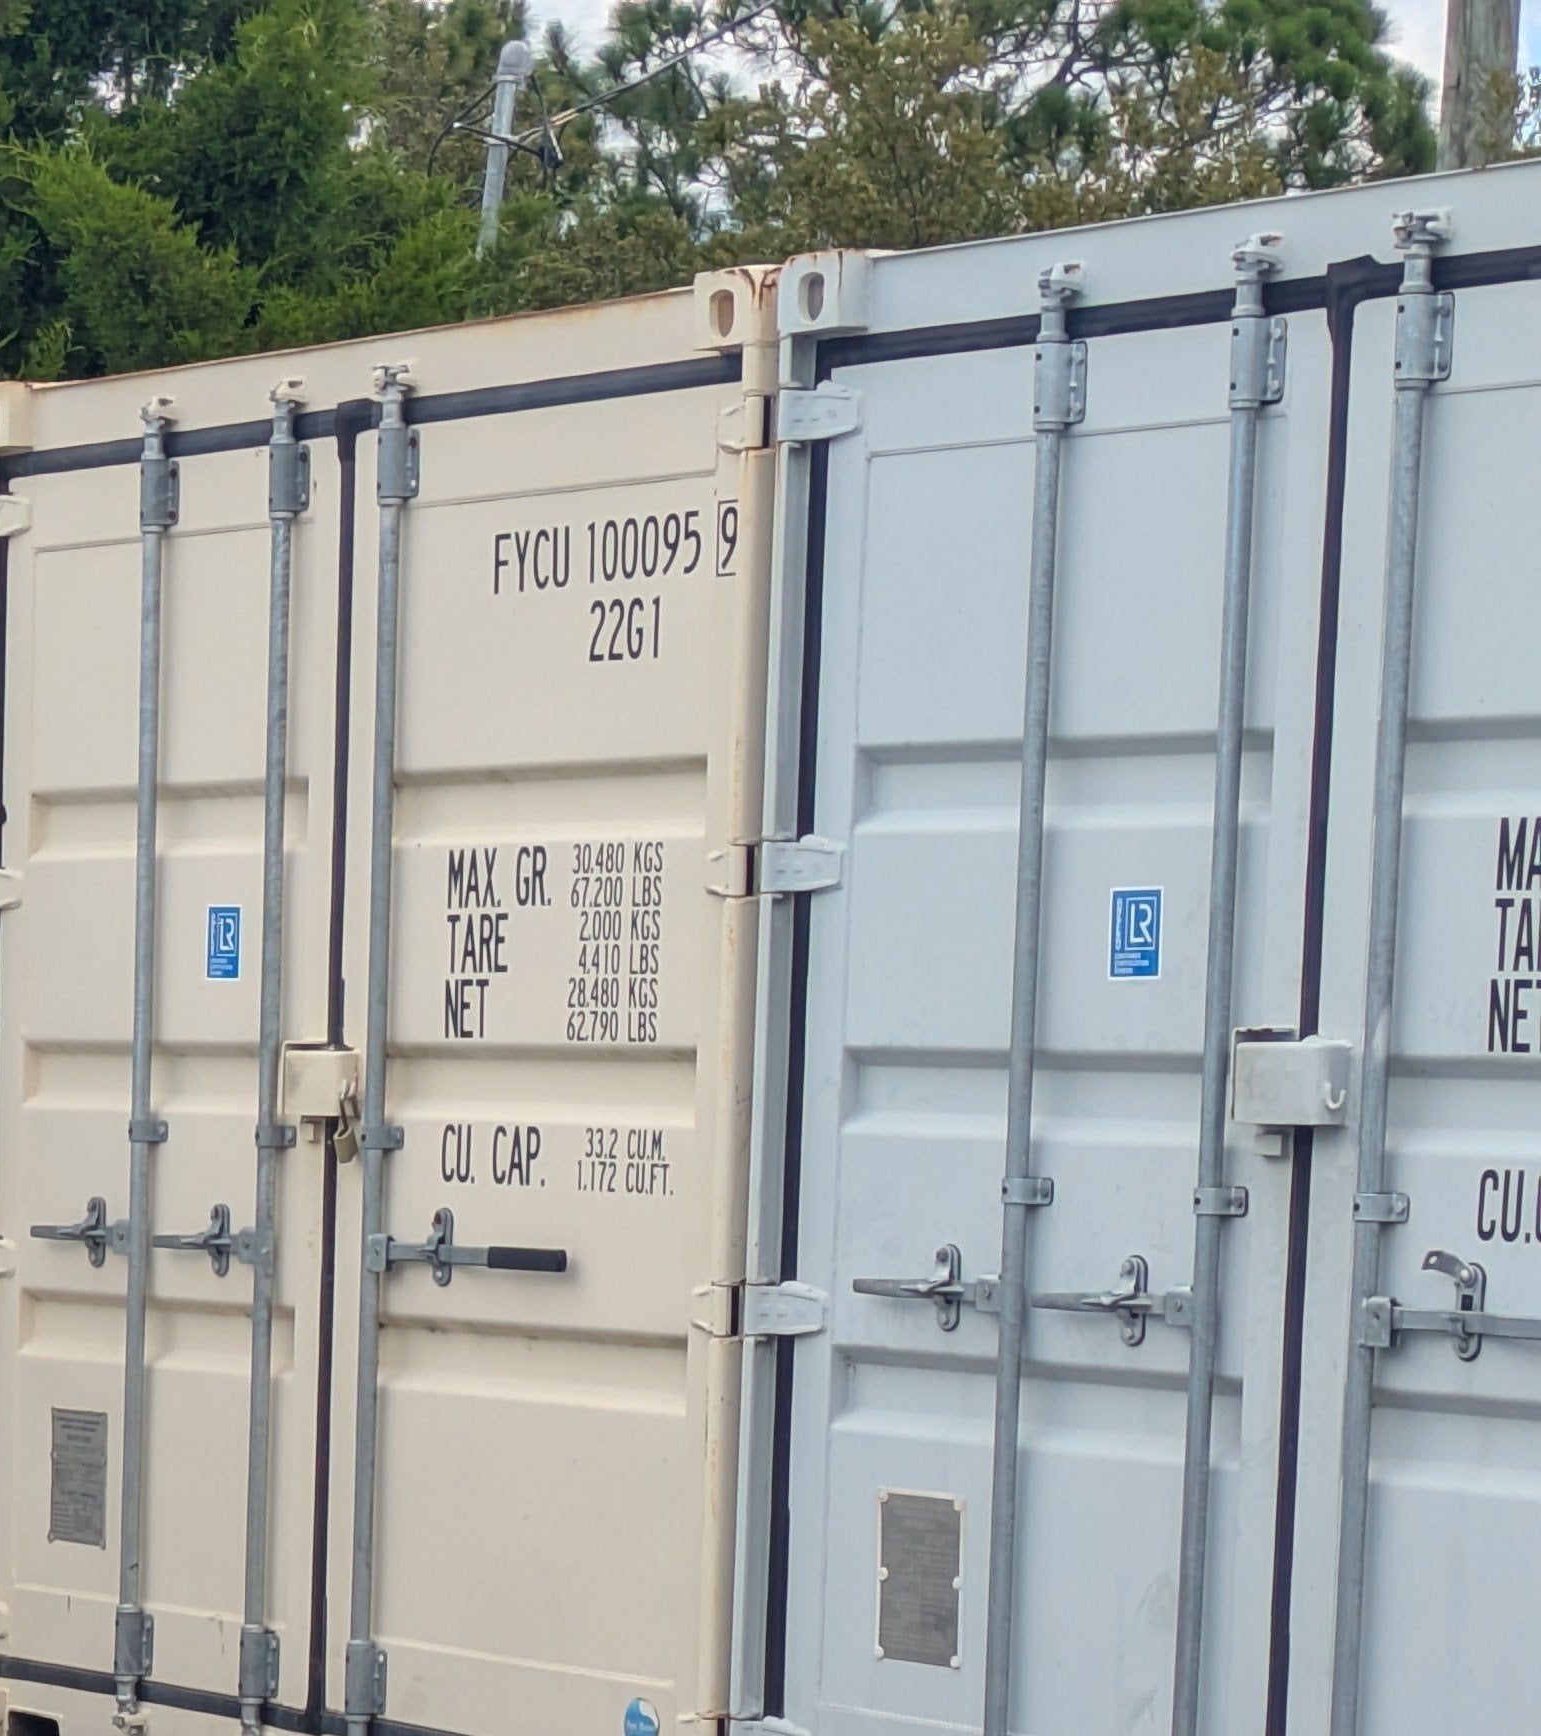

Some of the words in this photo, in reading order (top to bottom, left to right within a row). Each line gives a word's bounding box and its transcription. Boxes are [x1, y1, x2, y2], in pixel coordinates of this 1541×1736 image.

[493, 525, 571, 595] FYCU
[588, 510, 702, 584] 100095
[720, 506, 739, 571] 9
[588, 596, 661, 662] 22G1
[446, 847, 502, 909] MAX.
[516, 845, 552, 907] GR.
[572, 842, 625, 874] 30.480
[632, 841, 664, 873] KGS
[570, 876, 623, 908] 67.200
[631, 875, 663, 908] LBS
[446, 912, 509, 974] TARE
[630, 910, 661, 941] KGS
[1130, 902, 1153, 943] LR
[1495, 898, 1541, 972] TA
[629, 943, 660, 975] LBS
[444, 978, 490, 1039] NET
[567, 977, 620, 1009] 28.480
[627, 977, 659, 1009] KGS
[1487, 979, 1541, 1053] NE
[566, 1010, 619, 1042] 62.790
[627, 1010, 658, 1043] LBS
[441, 1123, 476, 1184] CU.
[492, 1125, 546, 1187] CAP.
[584, 1127, 619, 1159] 33.2
[576, 1160, 617, 1194] 1.172
[1477, 1168, 1541, 1243] CU.
